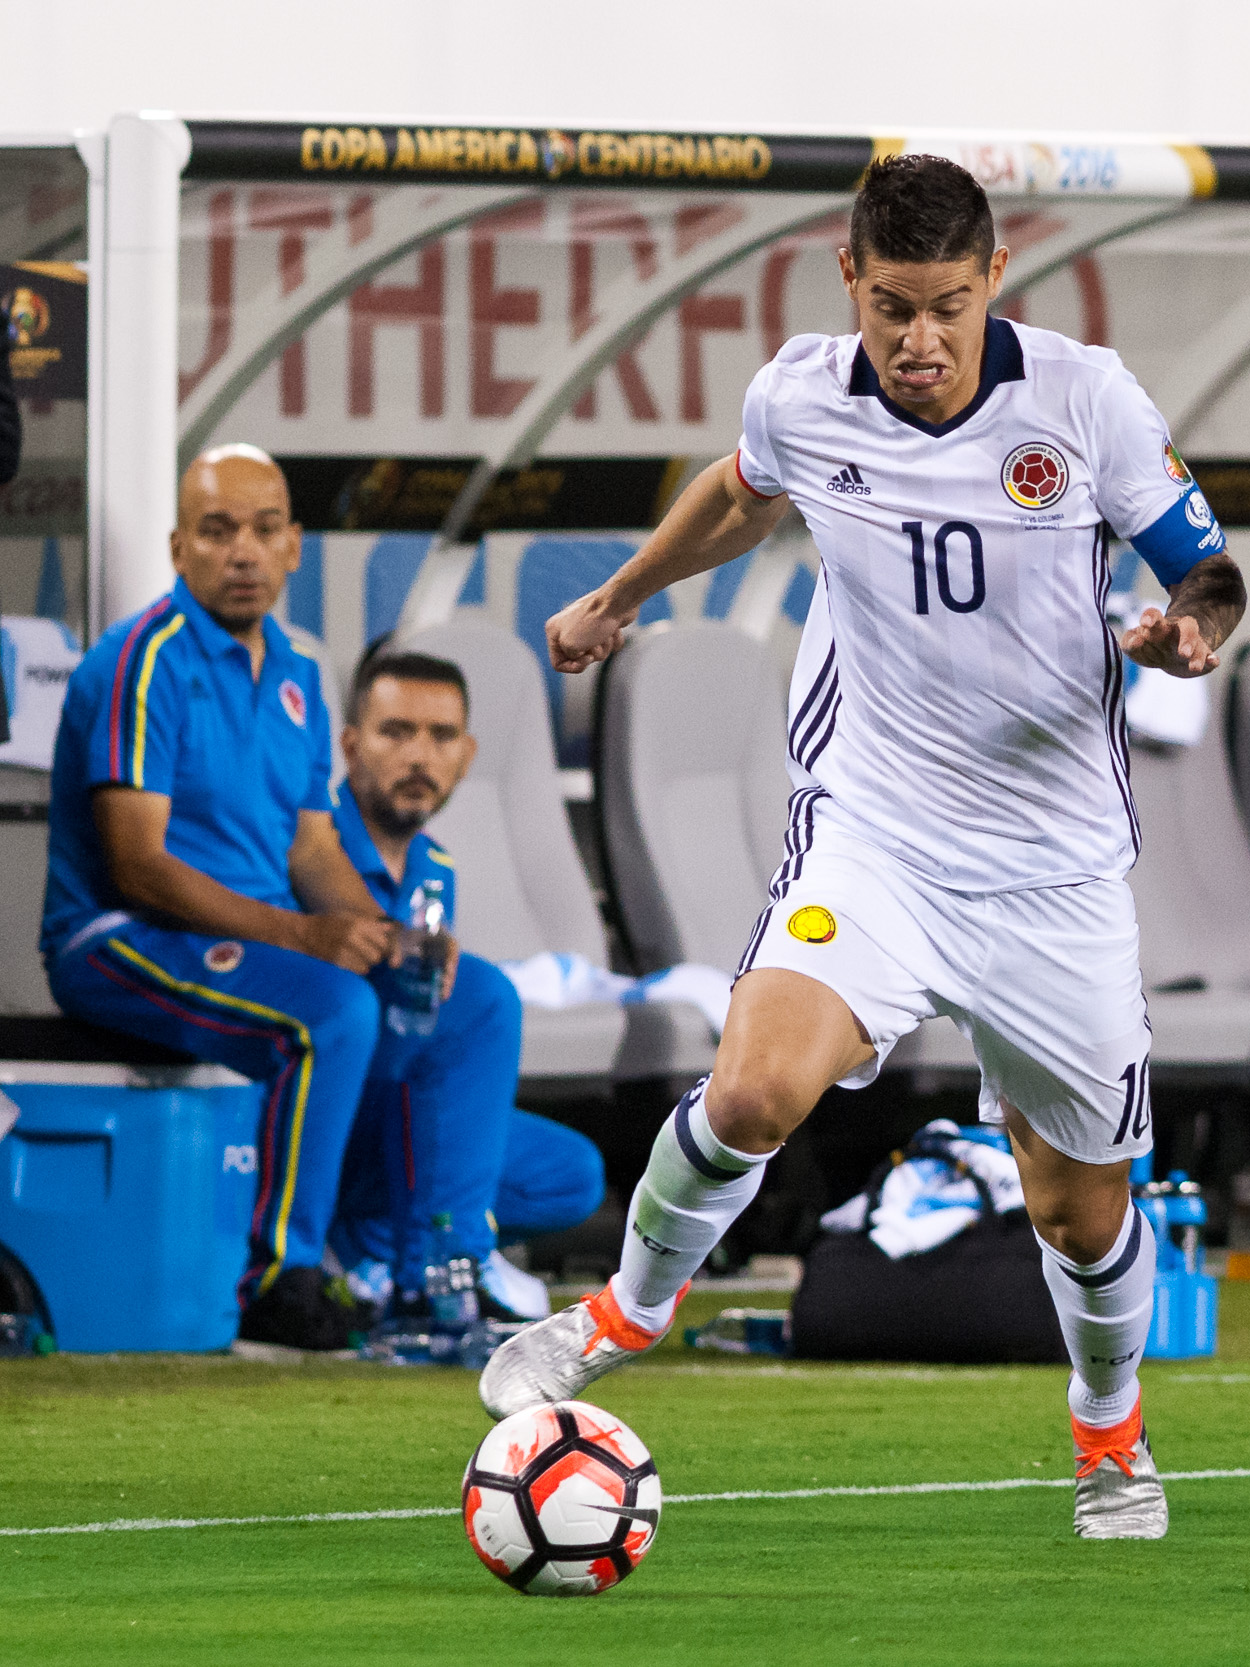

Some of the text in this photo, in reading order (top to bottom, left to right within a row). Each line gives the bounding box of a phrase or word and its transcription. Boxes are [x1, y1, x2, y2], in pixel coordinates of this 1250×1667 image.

[301, 127, 772, 179] COPA AMERICA CENTENARIO
[827, 481, 872, 495] adidas
[902, 520, 986, 615] 10
